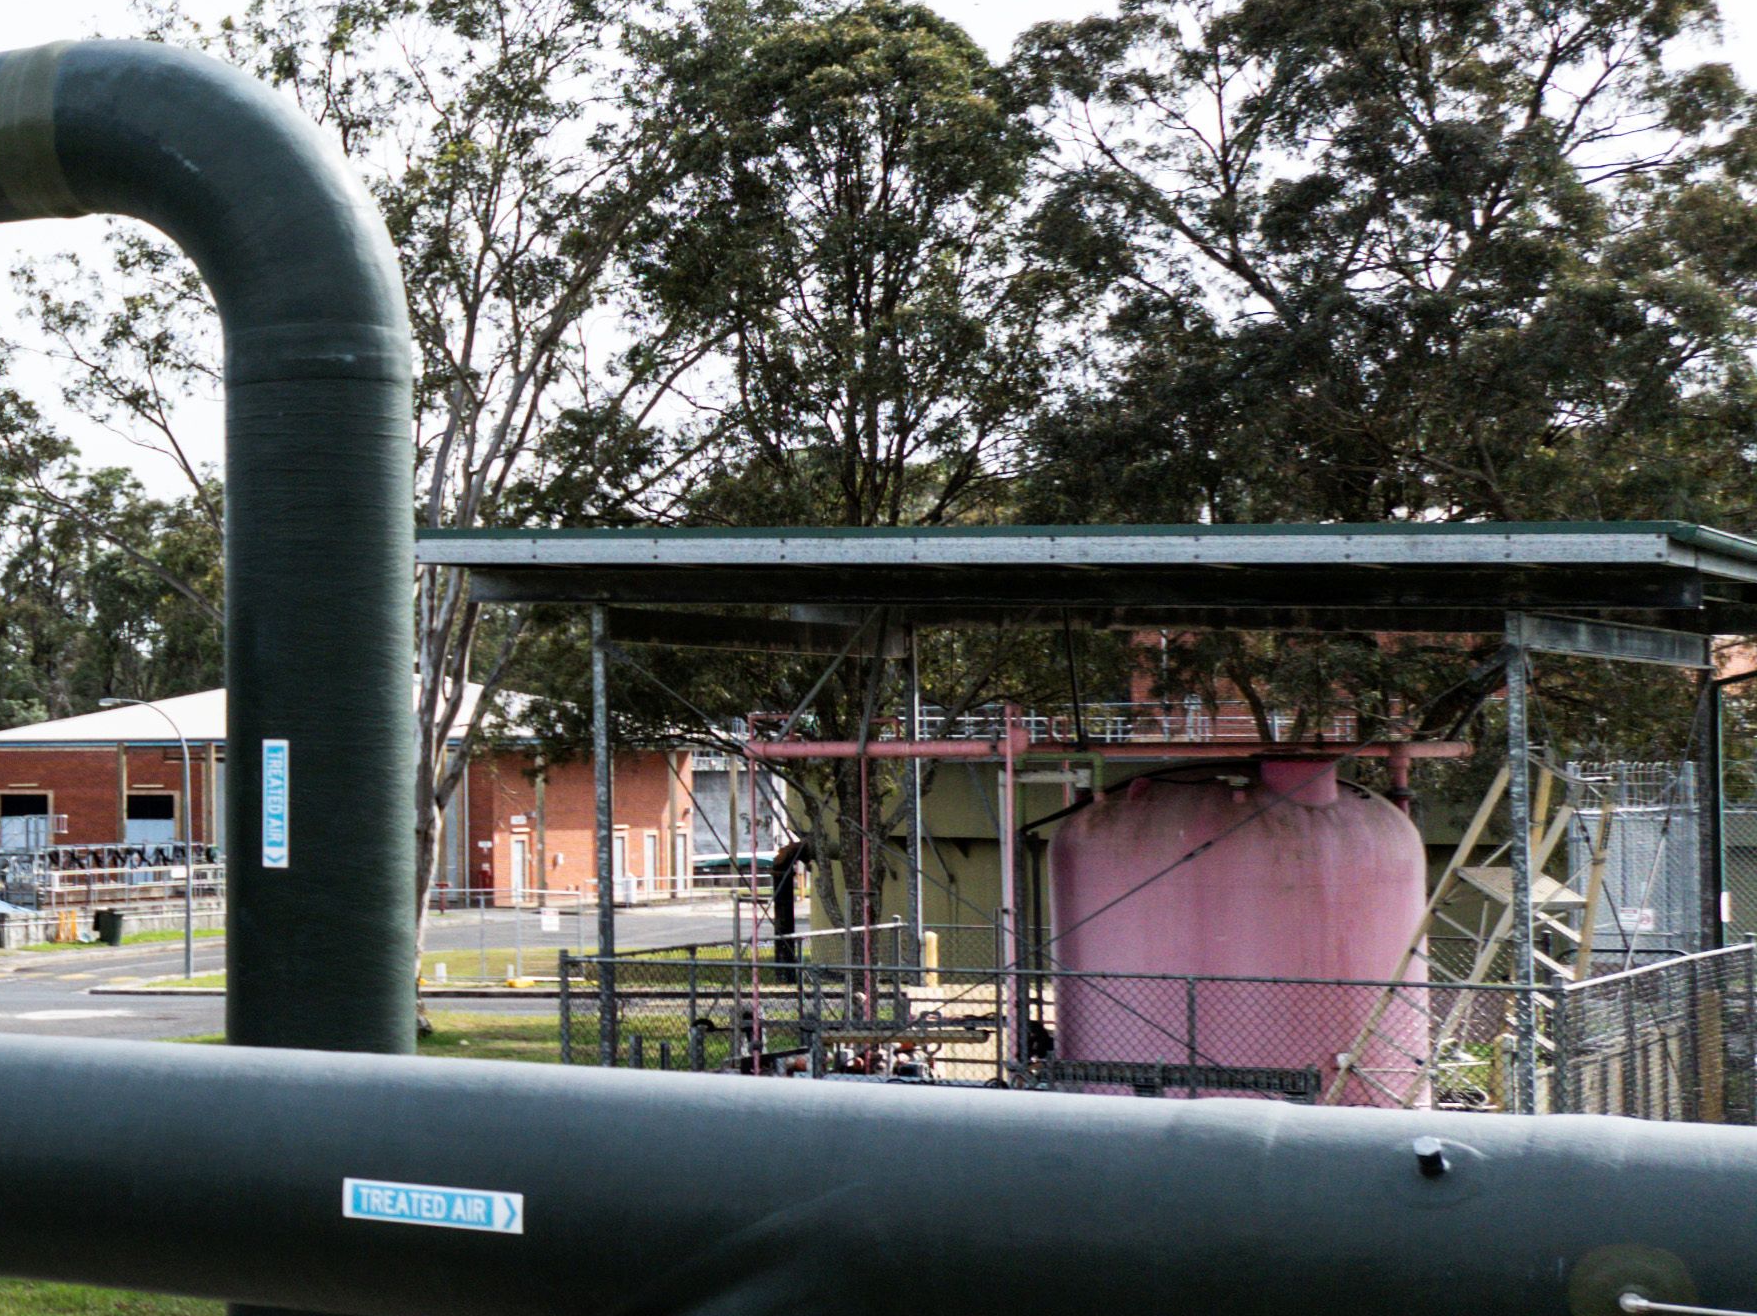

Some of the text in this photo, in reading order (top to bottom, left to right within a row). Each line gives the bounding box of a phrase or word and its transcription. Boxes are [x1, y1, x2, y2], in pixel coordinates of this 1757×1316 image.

[268, 751, 284, 842] TREATED AIR
[358, 1186, 485, 1223] TREATED AIR
